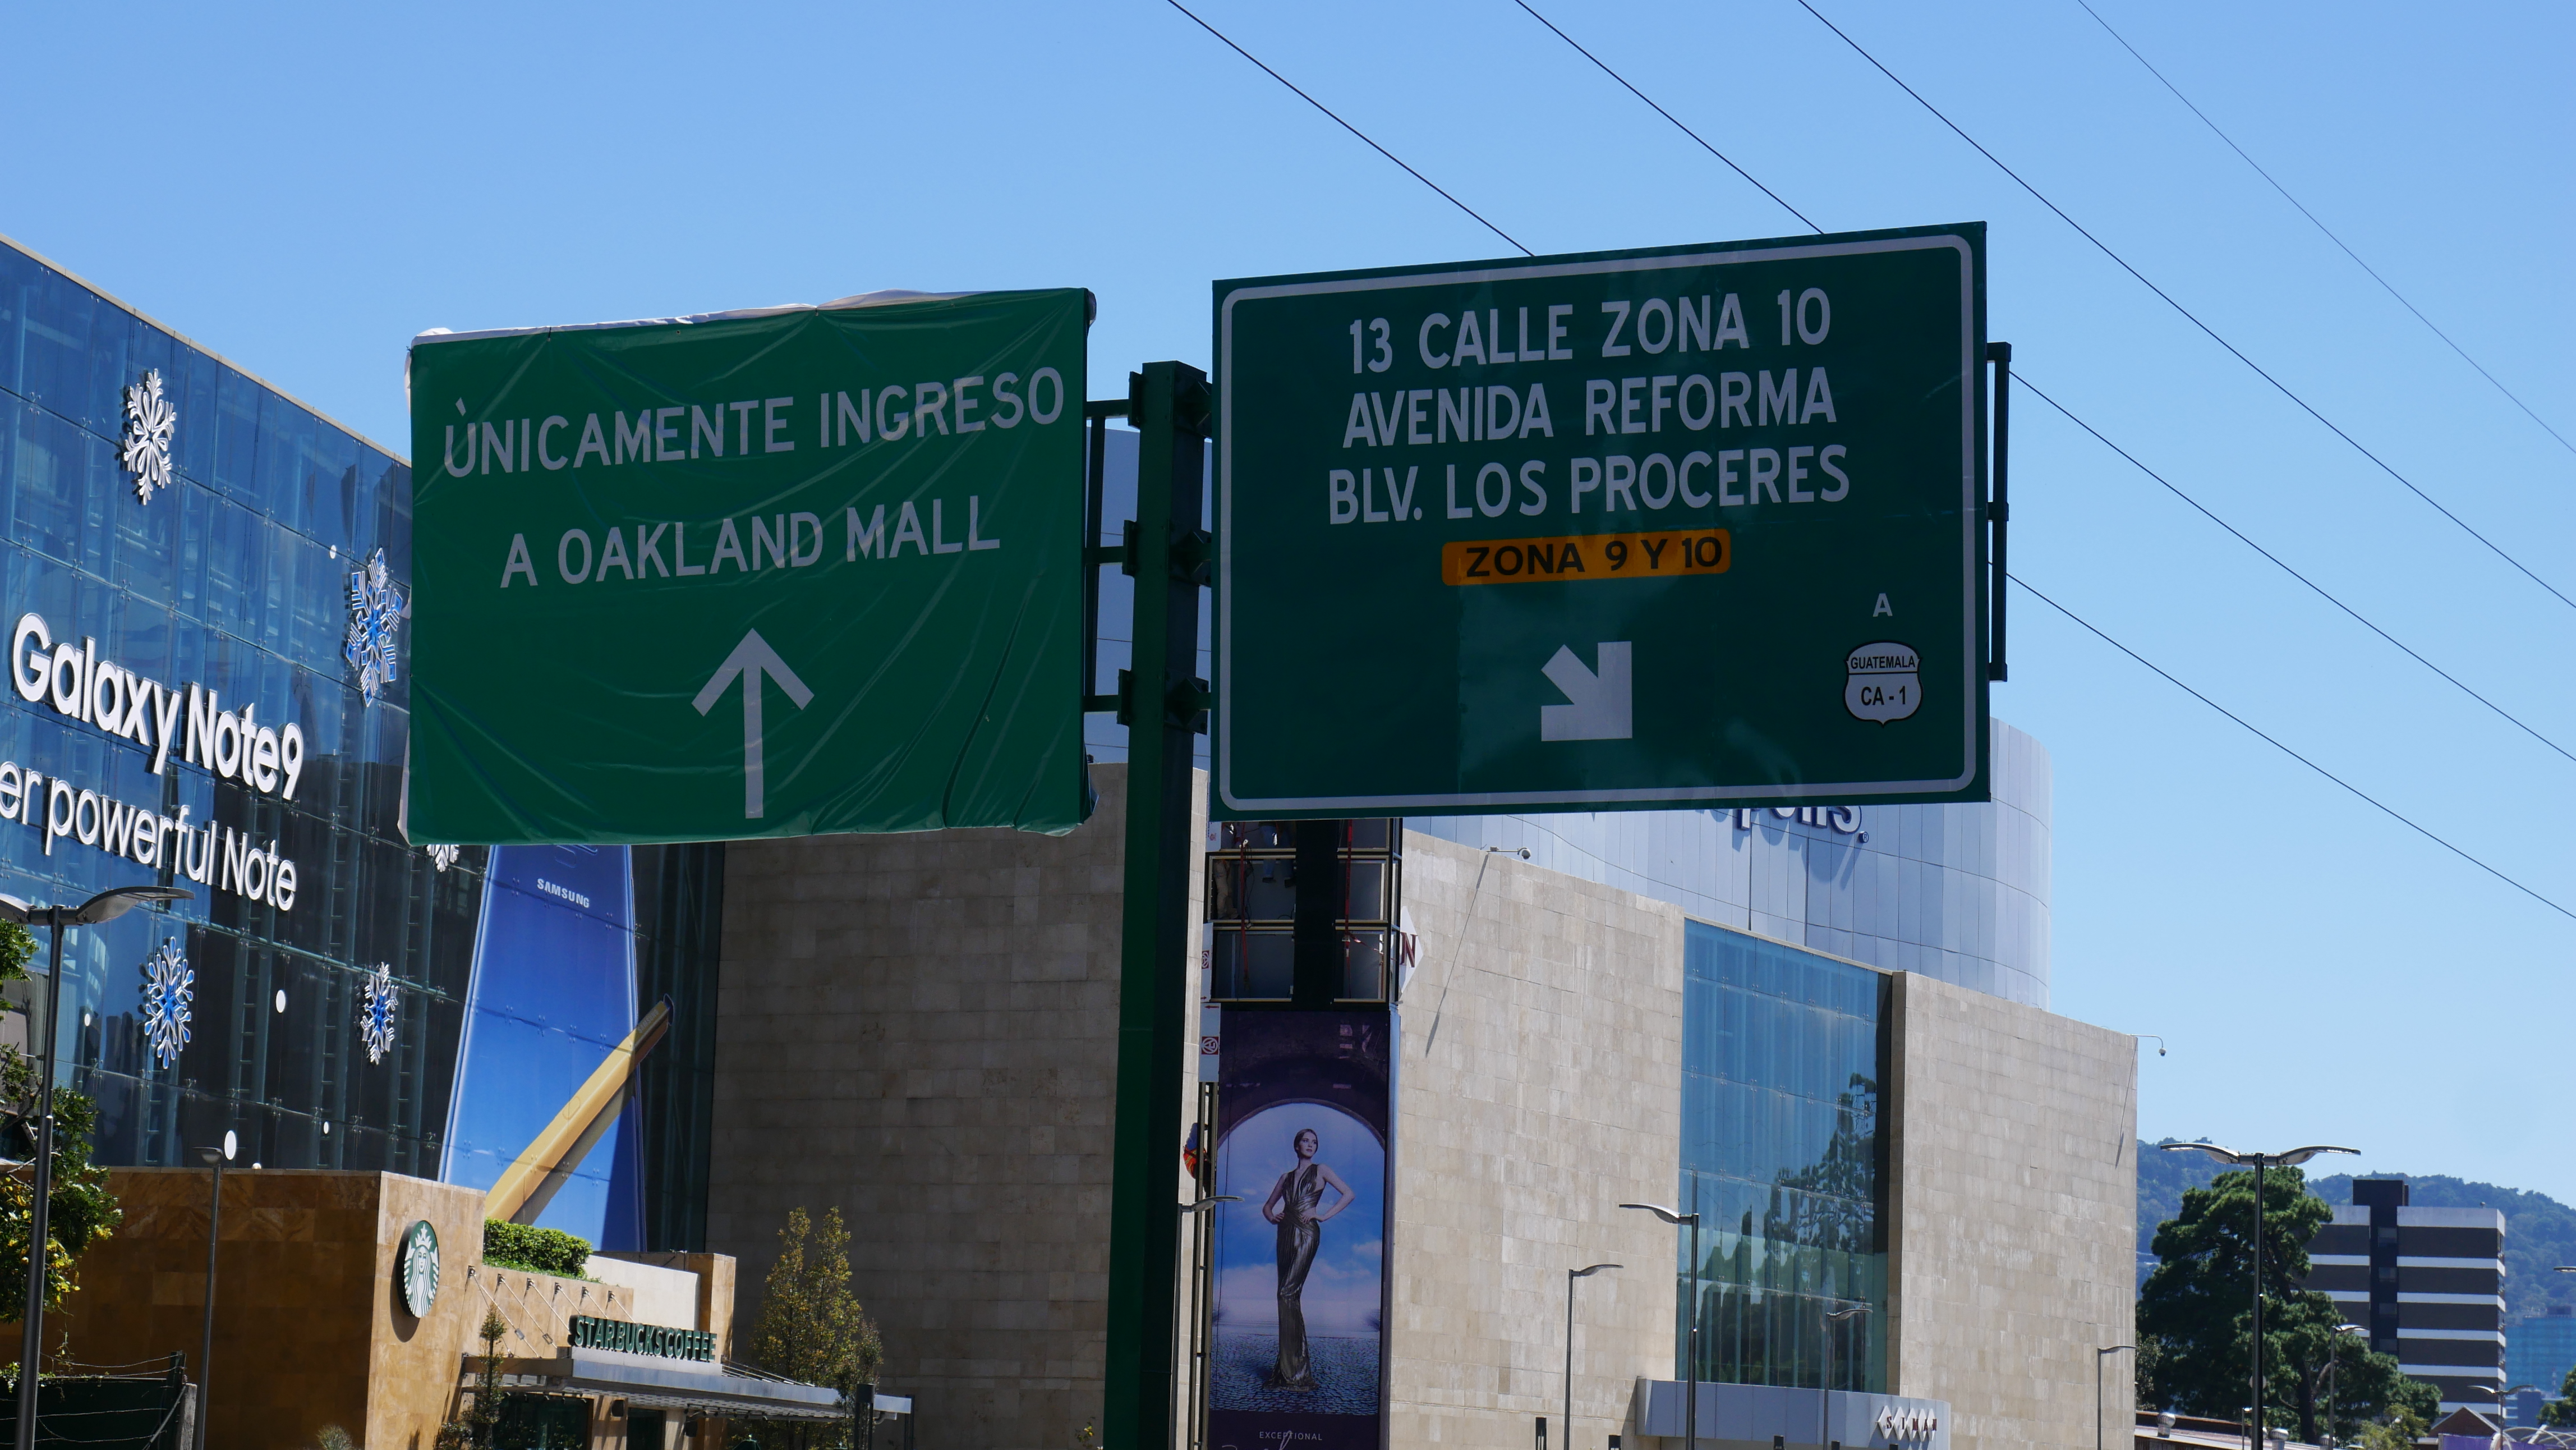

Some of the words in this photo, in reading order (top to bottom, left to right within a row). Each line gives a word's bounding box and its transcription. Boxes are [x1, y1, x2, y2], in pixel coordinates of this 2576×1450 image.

[1350, 318, 1392, 374] 13
[1419, 304, 1572, 369] CALLE
[1602, 293, 1750, 357] ZONA
[1778, 287, 1830, 346] 10
[821, 367, 1064, 447] INGRESO
[1342, 383, 1554, 448] AVENIDA
[1586, 367, 1836, 435] REFORMA
[1330, 466, 1422, 525] BLV.
[1447, 460, 1547, 519] LOS
[1571, 444, 1849, 513] PROCERES
[500, 533, 538, 588] A
[558, 512, 823, 584] OAKLAND
[847, 495, 1000, 562] MALL
[1466, 543, 1585, 577] ZONA
[1605, 540, 1627, 571] 9
[1641, 539, 1668, 570] Y
[1681, 536, 1722, 568] 10
[1873, 593, 1893, 617] A
[1851, 655, 1915, 669] GUATEMALA
[13, 613, 181, 775] Galaxy
[45, 776, 217, 885] powerful
[222, 827, 297, 911] Note
[537, 878, 590, 908] SAMSUNG
[573, 1315, 664, 1356] STARBUCKS
[665, 1327, 717, 1362] COFFEE
[1259, 1431, 1323, 1440] EXCEPTIONAL
[1886, 1415, 1937, 1431] SIMAN
